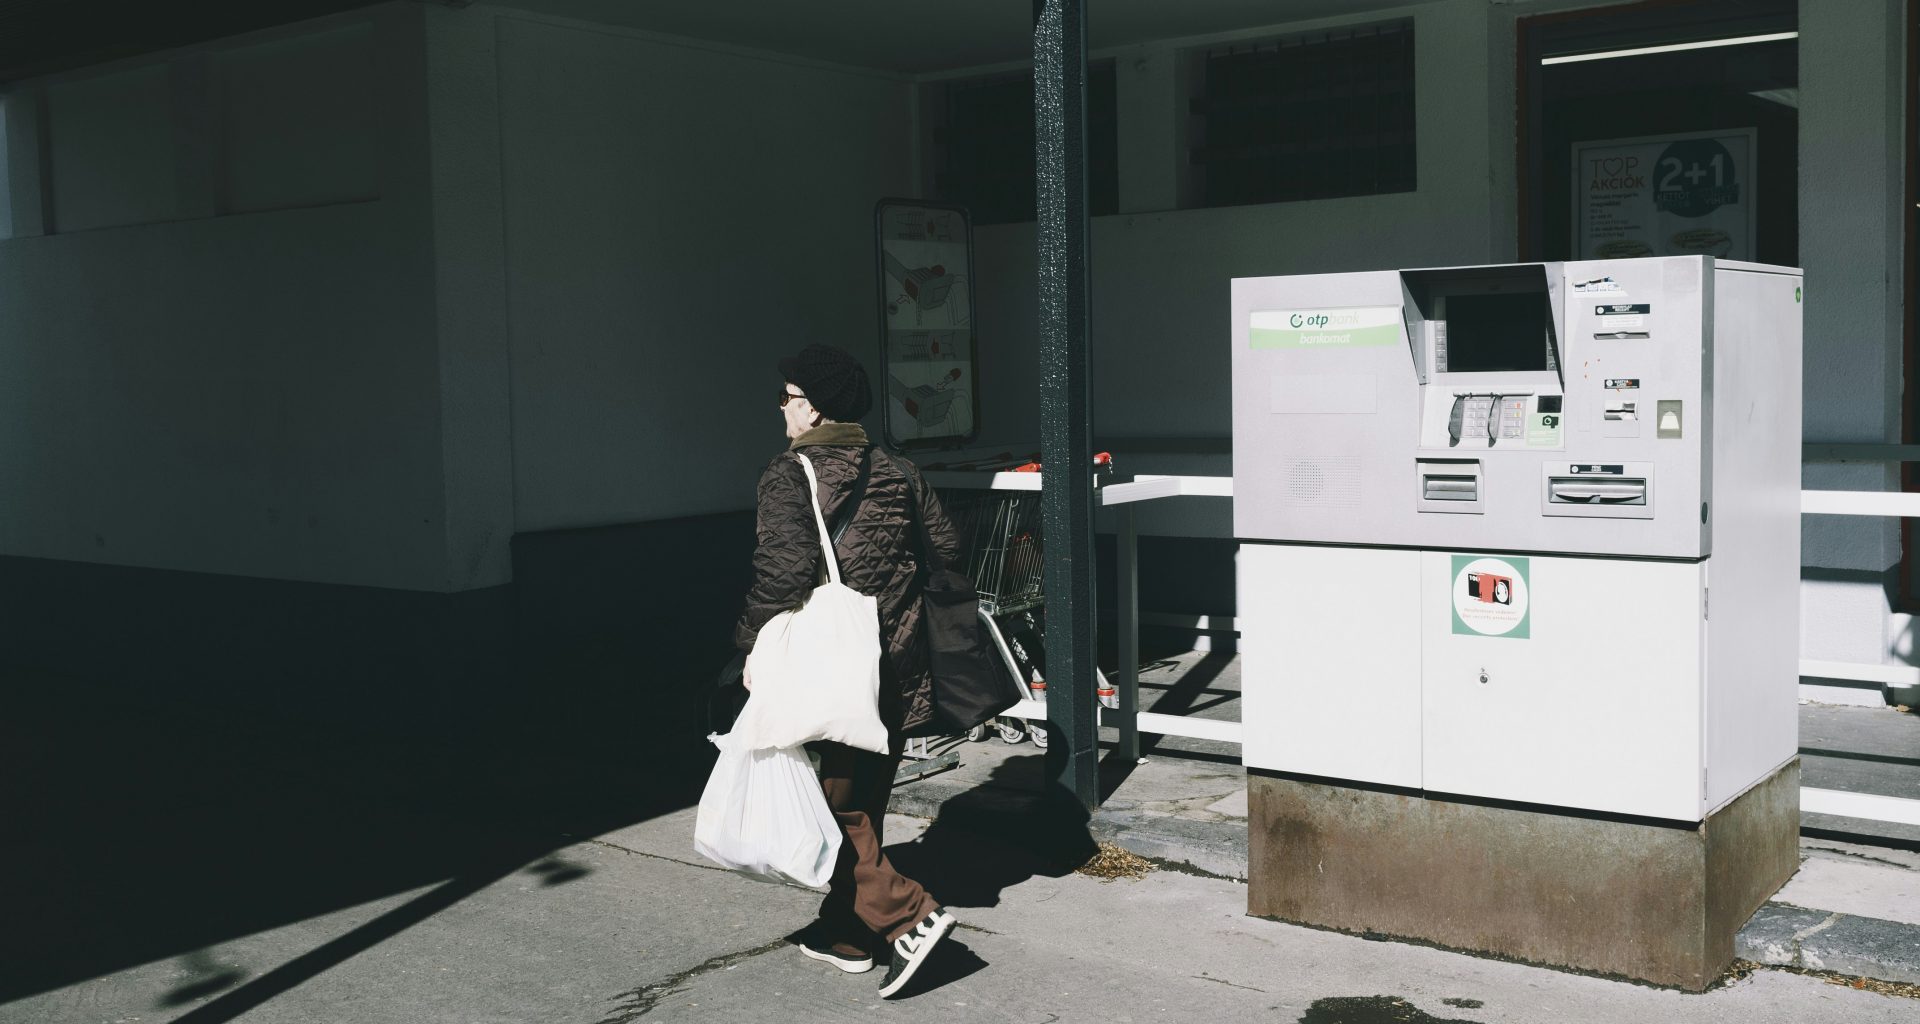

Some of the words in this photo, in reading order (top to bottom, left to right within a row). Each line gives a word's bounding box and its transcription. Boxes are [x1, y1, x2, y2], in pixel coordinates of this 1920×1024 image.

[1659, 153, 1724, 191] 2+1
[1590, 174, 1645, 191] AKCIÓK
[1300, 332, 1350, 345] bankomat
